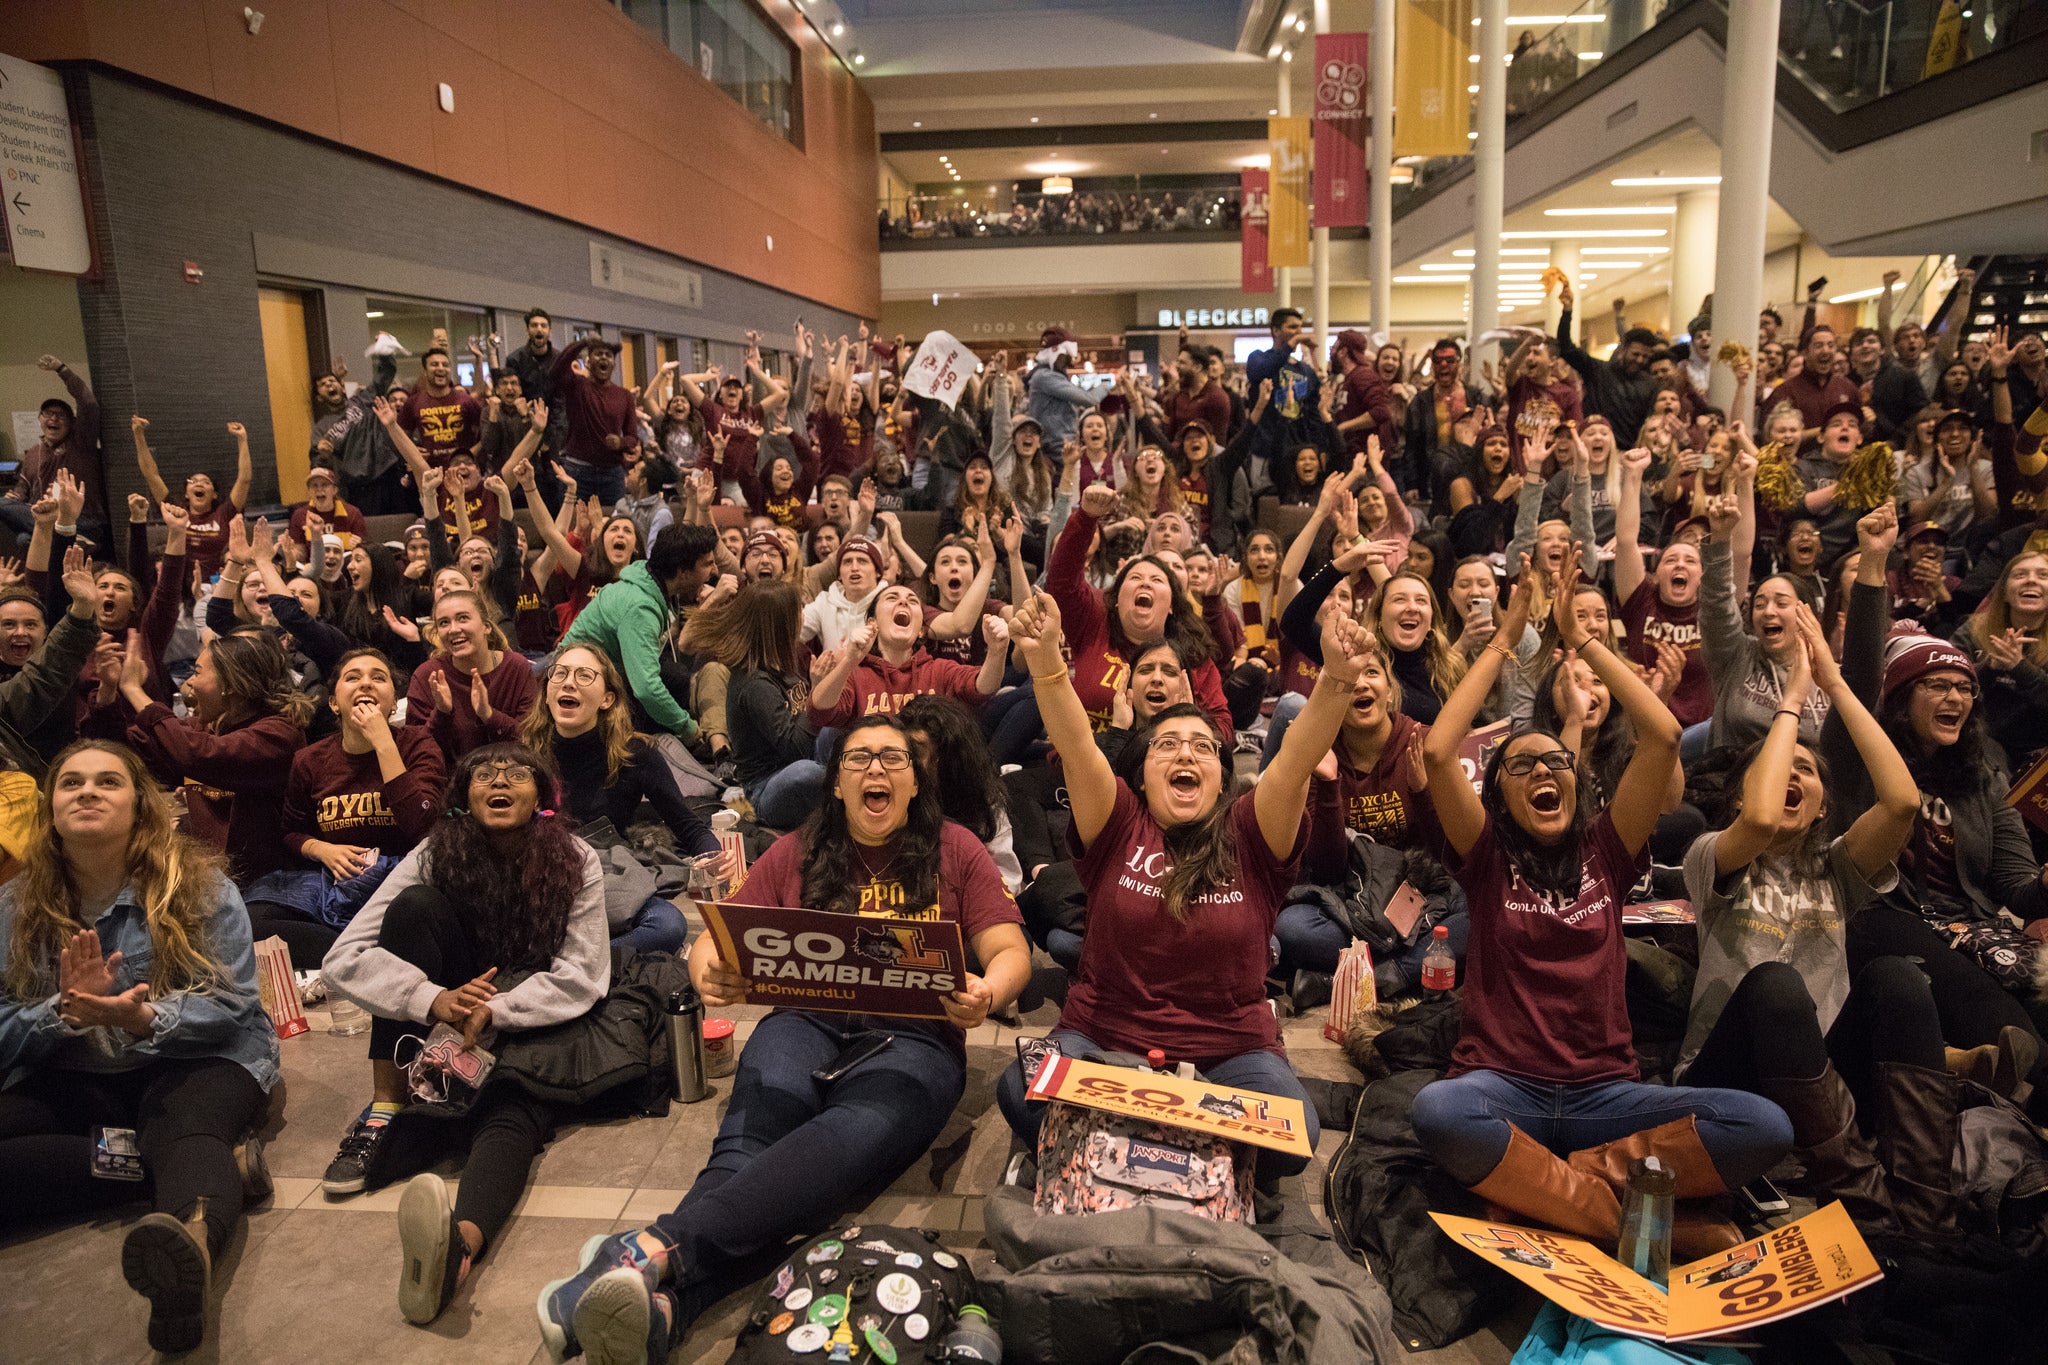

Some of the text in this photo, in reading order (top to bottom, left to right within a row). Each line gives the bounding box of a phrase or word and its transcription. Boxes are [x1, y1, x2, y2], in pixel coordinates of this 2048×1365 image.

[0, 114, 49, 136] Development
[26, 107, 68, 127] Leadership
[1317, 109, 1364, 120] CONNECT
[0, 132, 67, 158] Student Activities
[3, 147, 9, 159] &
[11, 149, 34, 164] Greek
[36, 155, 60, 170] Affairs
[19, 171, 41, 186] PNC
[17, 224, 46, 239] Cinema
[973, 322, 1015, 334] FOOD
[1158, 308, 1269, 327] BLEECKER
[943, 371, 957, 391] GO
[1926, 651, 1969, 665] Loyola
[368, 816, 397, 827] CHICA
[1587, 894, 1612, 914] CHICA
[1735, 917, 1785, 940] UNIVERS
[743, 927, 846, 962] GO
[752, 957, 956, 992] RAMBLERS
[755, 984, 857, 1000] #OnwardLU
[1078, 1077, 1185, 1106] GO
[1074, 1087, 1296, 1142] RAMBLERS
[1130, 1143, 1187, 1166] JANSPORT
[1771, 1224, 1825, 1298] RAMBLERS
[1543, 1273, 1650, 1324] GO
[1718, 1272, 1784, 1317] GO
